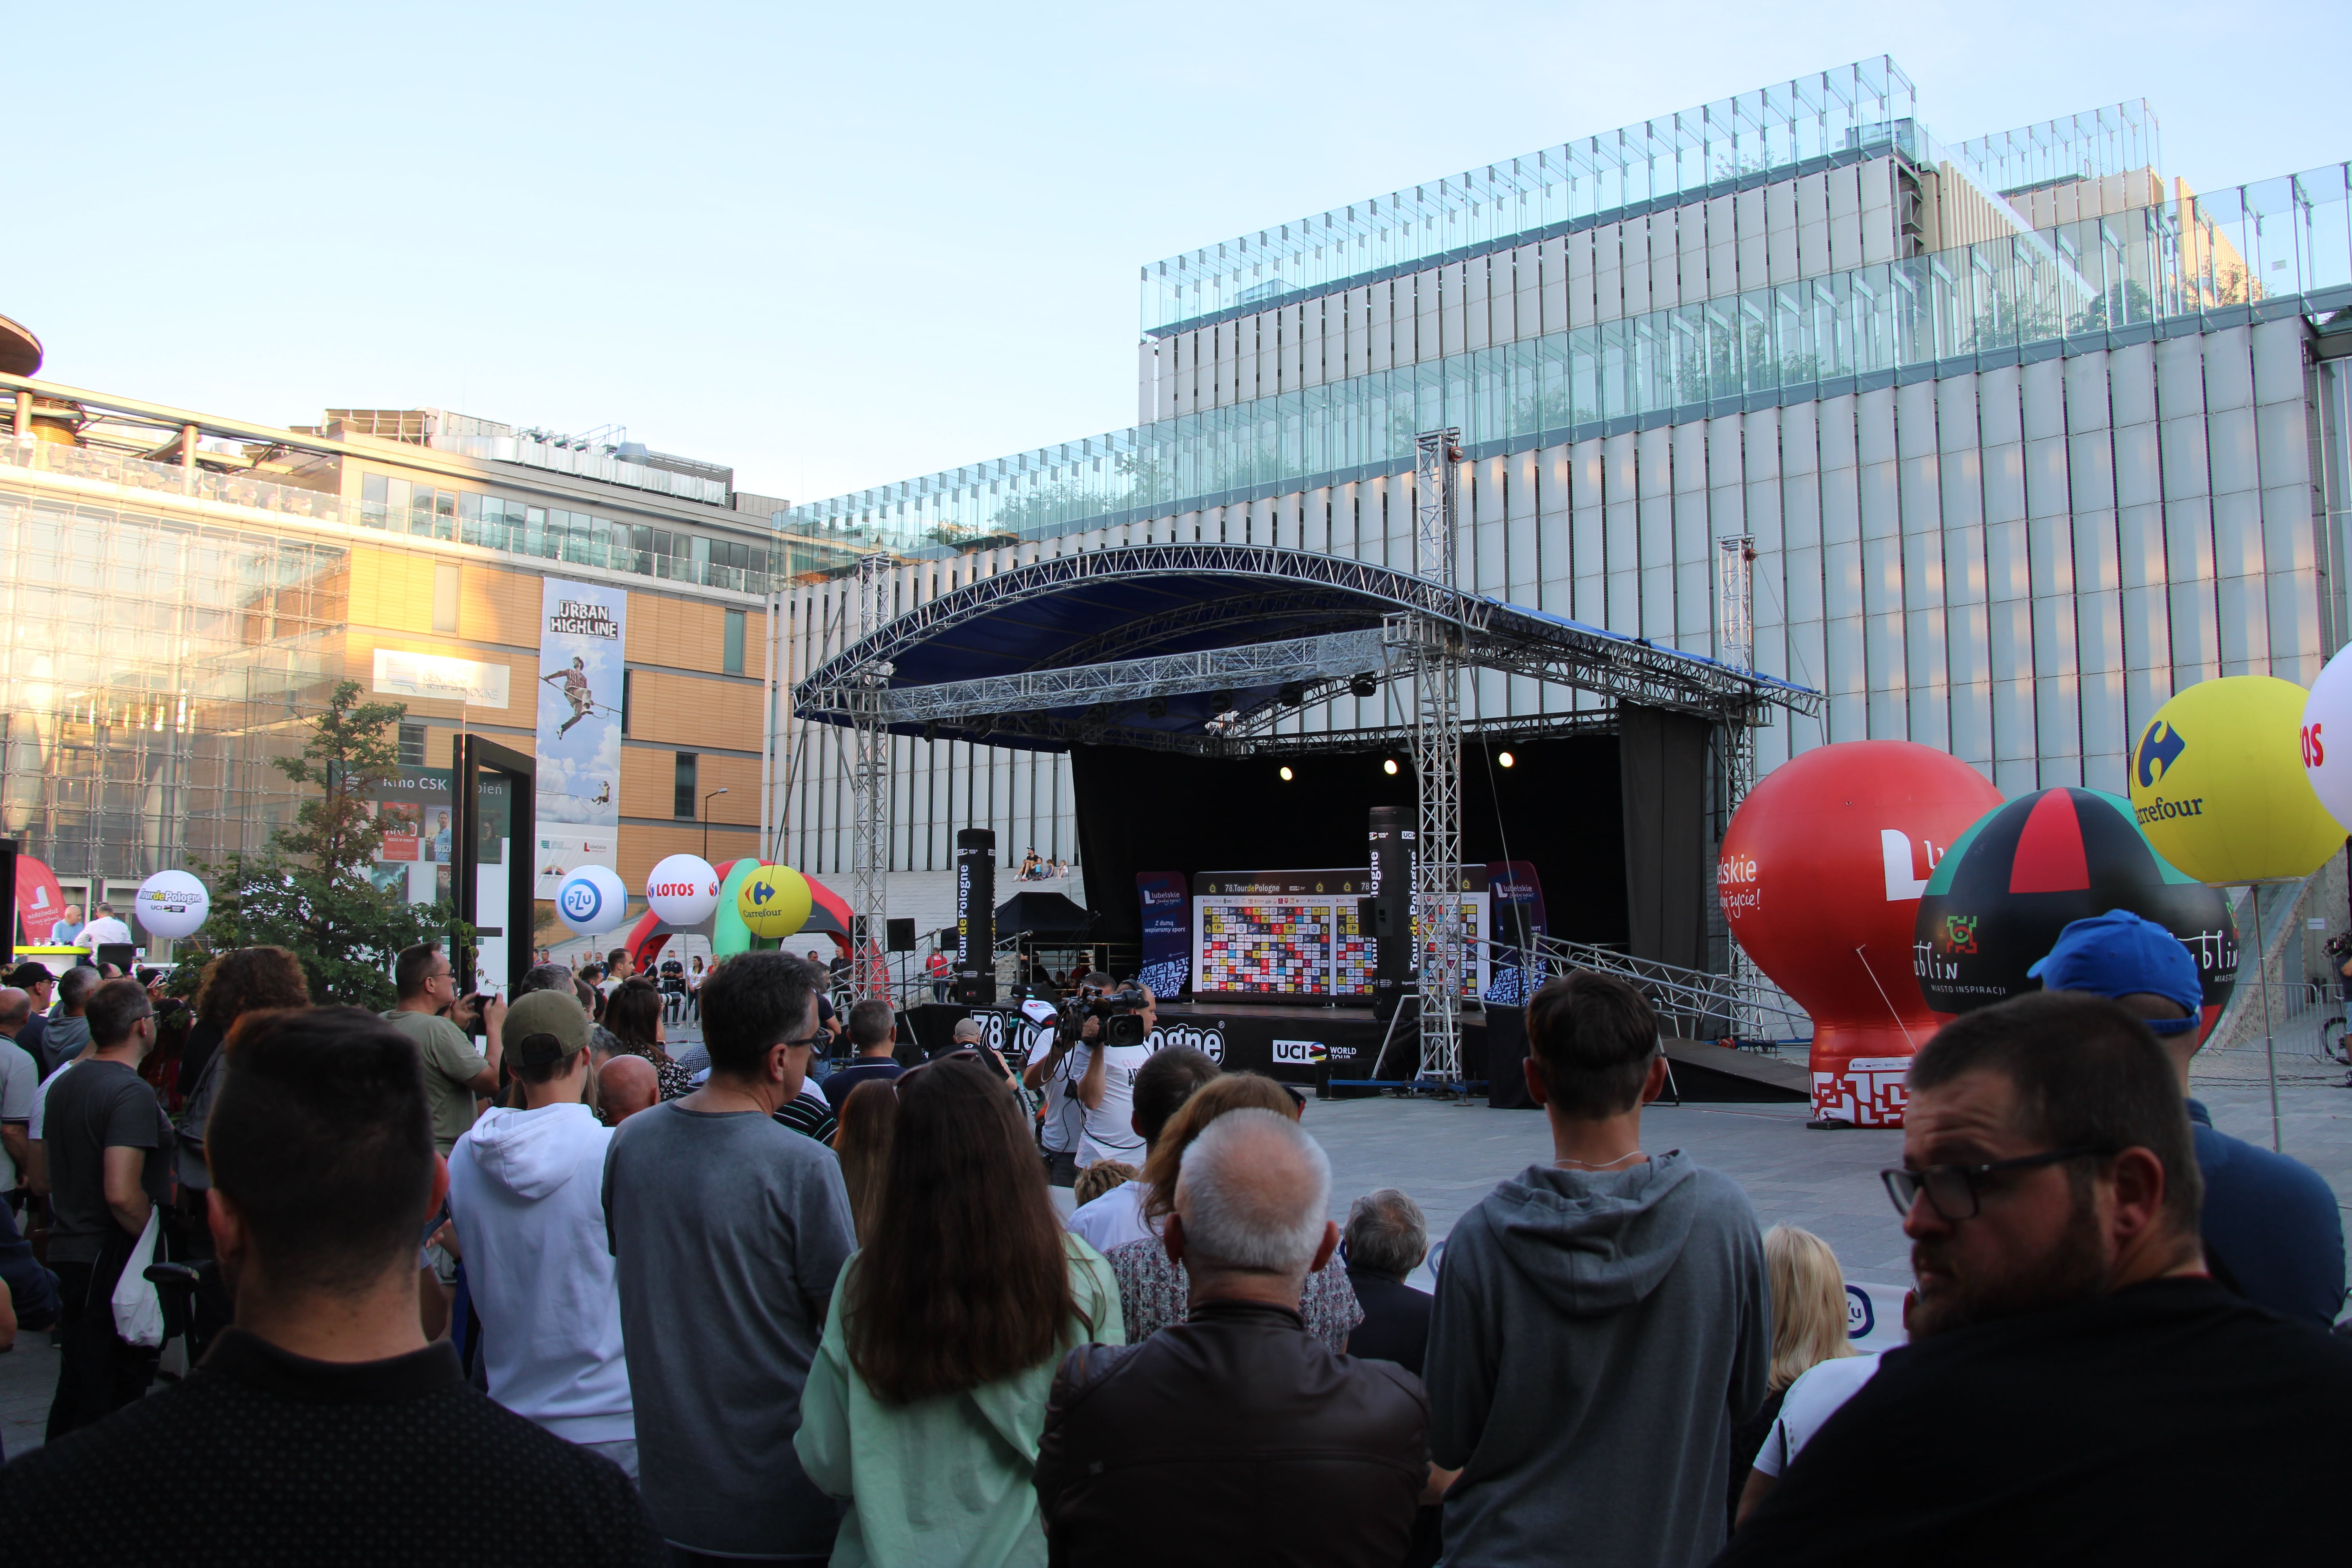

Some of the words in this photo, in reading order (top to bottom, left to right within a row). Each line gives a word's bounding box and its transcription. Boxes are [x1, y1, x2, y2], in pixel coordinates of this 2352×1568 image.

[560, 603, 608, 620] URBAN
[551, 617, 617, 637] HIGHLINE
[419, 777, 447, 790] CSK
[2132, 797, 2203, 826] arrefour
[139, 888, 202, 905] TourdePologne
[657, 883, 694, 897] LOTOS
[568, 890, 592, 910] PZU
[743, 908, 782, 918] Carrefour
[958, 864, 971, 964] TourdePologne
[1931, 984, 1953, 993] MIASTO
[1956, 985, 2005, 995] INSPIRACJI
[1277, 1044, 1306, 1060] UCI
[1330, 1046, 1357, 1055] WORLD
